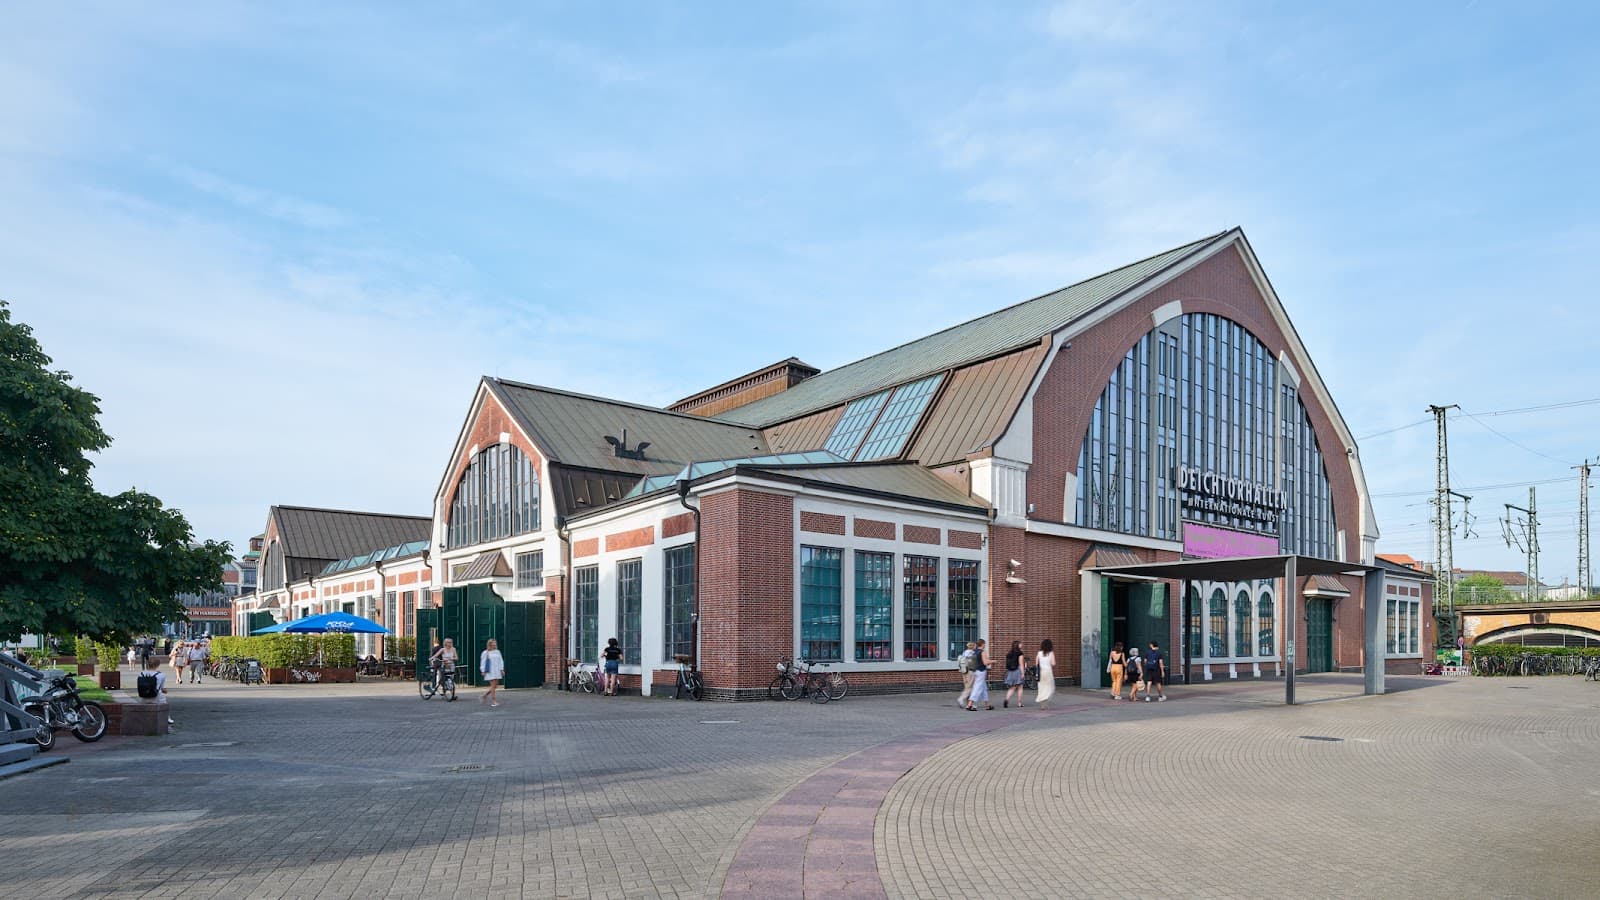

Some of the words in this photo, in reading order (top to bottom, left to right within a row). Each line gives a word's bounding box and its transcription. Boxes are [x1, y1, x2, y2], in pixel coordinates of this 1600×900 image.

[1177, 466, 1287, 510] DEICHTORHALLEN
[1188, 497, 1255, 518] INTERNATIONALE
[1256, 511, 1279, 523] KUNST
